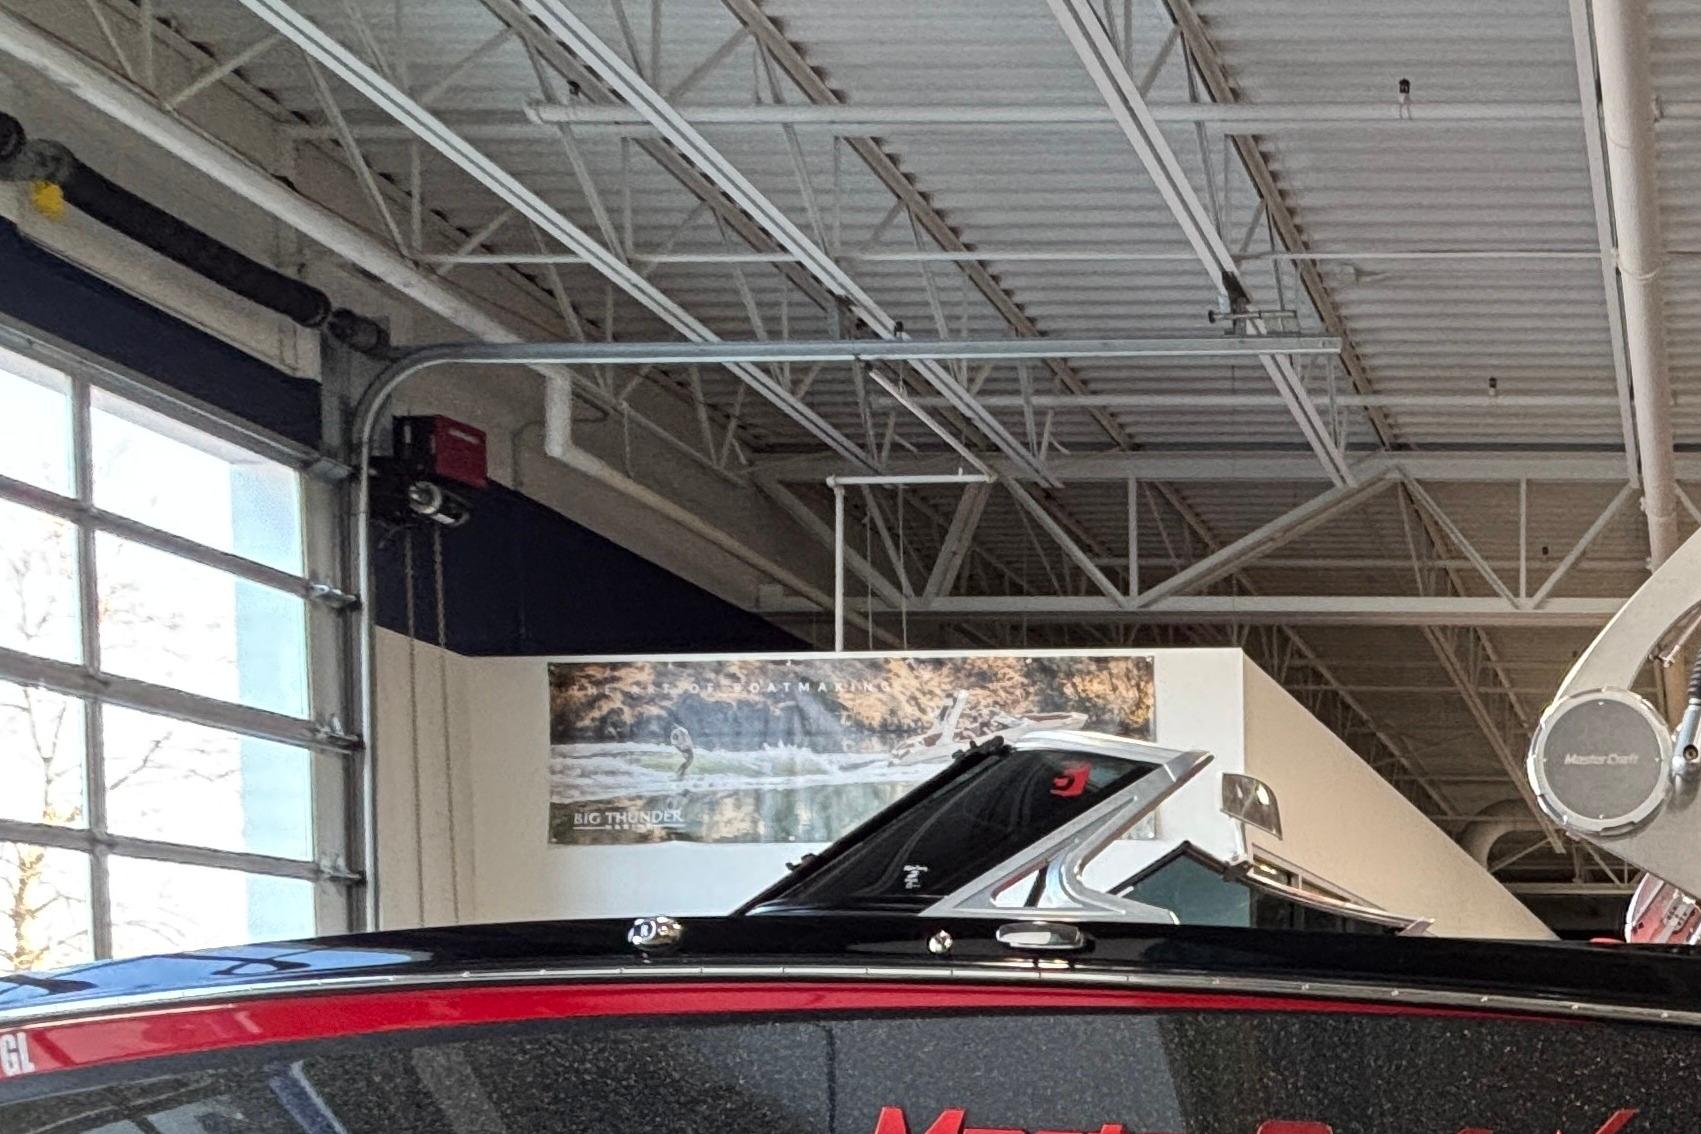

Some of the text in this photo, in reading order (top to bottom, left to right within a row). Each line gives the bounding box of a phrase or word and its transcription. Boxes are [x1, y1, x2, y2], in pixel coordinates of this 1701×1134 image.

[690, 682, 715, 694] OF
[573, 809, 684, 825] BIG THUNDER
[0, 1031, 36, 1077] GL
